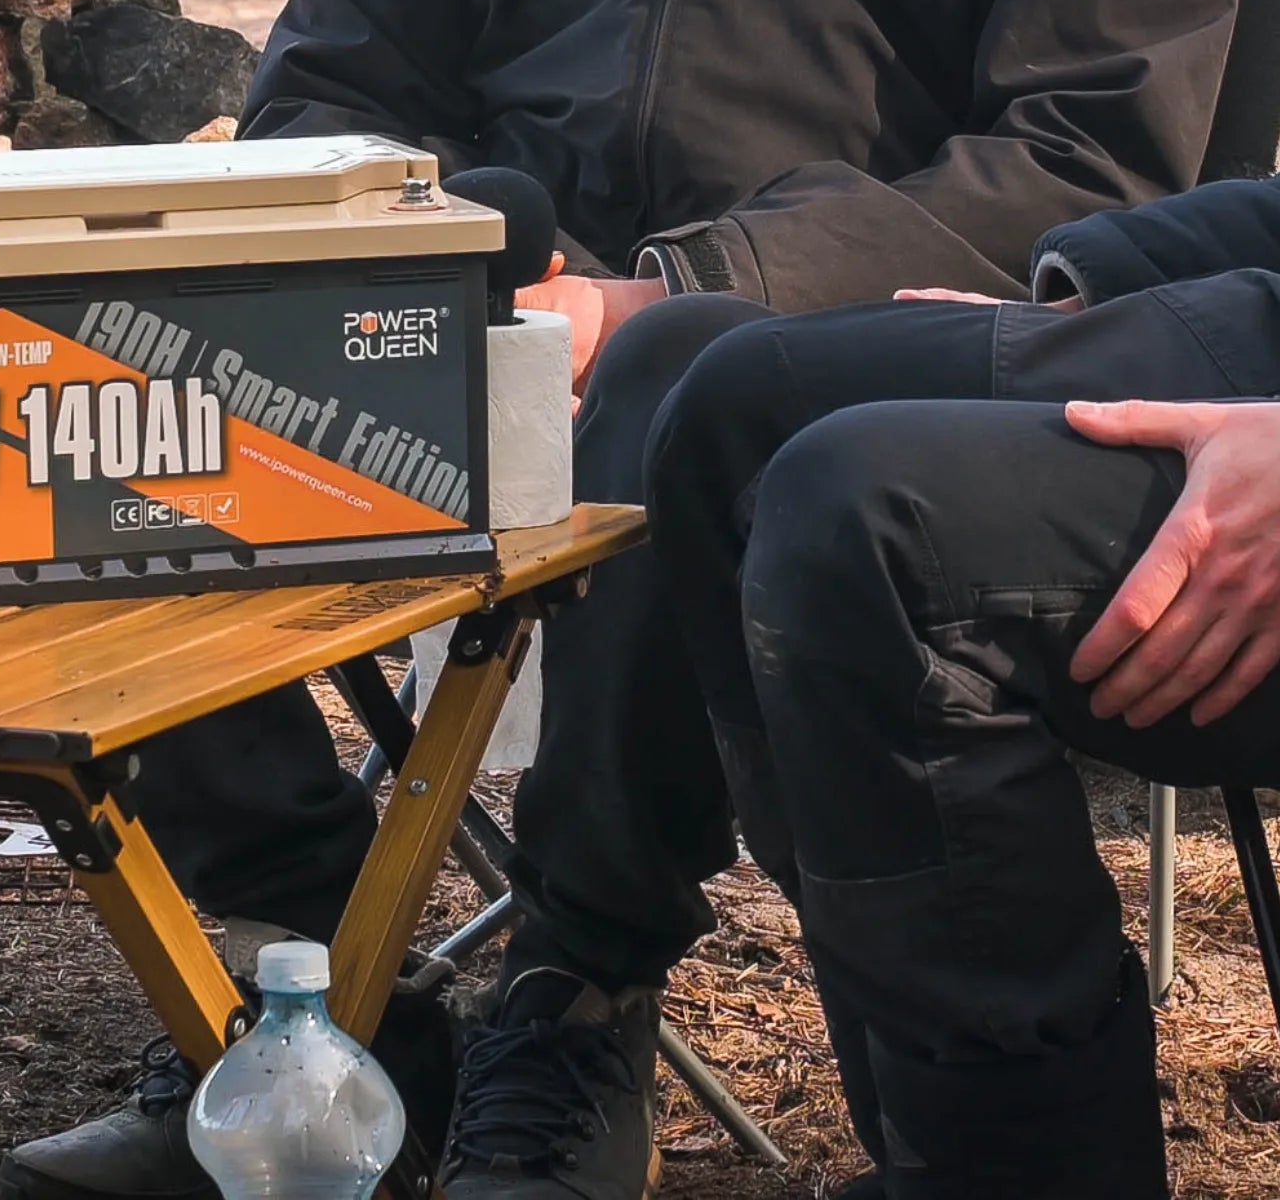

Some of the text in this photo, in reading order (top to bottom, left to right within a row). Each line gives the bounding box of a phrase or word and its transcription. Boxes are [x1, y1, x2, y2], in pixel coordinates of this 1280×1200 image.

[344, 308, 438, 335] POWER
[344, 332, 438, 361] QUEEN
[20, 376, 223, 485] 140Ah
[204, 348, 339, 454] Smart
[239, 443, 373, 513] www.ipowerqueen.com
